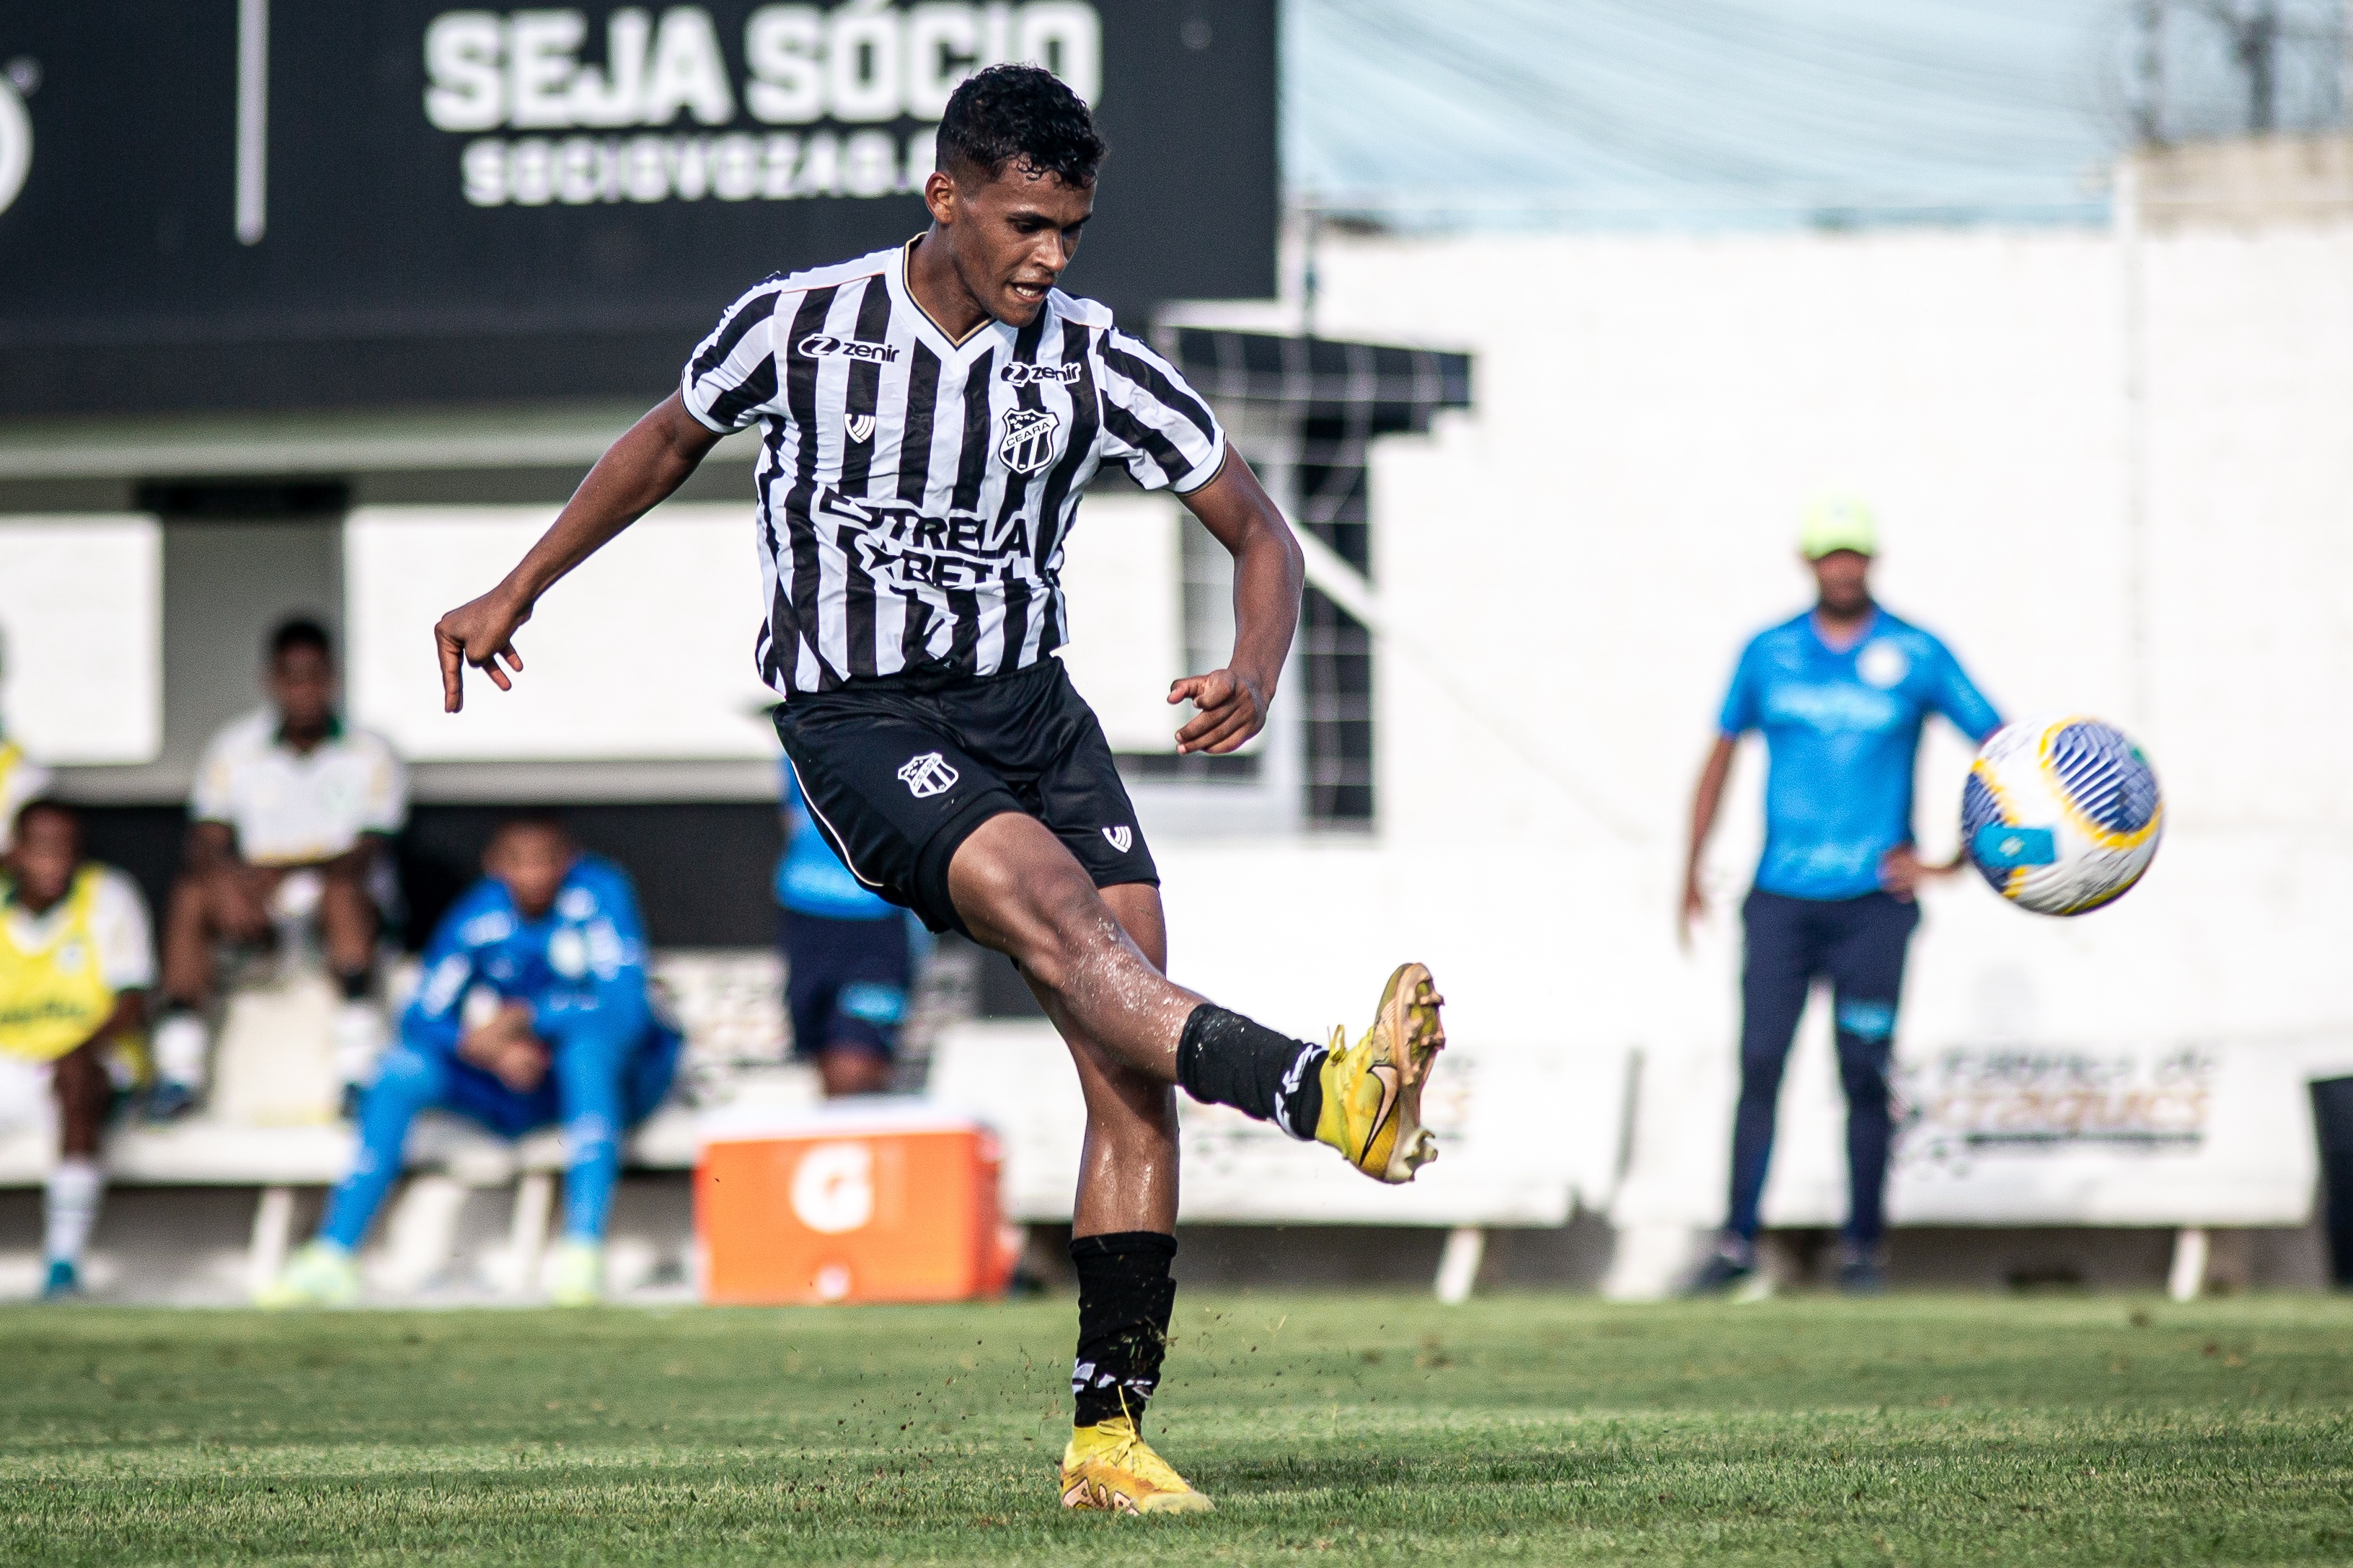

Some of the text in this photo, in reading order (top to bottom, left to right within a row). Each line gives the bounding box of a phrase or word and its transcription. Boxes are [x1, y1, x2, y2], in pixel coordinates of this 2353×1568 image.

[425, 0, 1102, 130] SEJA SÓCIO
[842, 344, 900, 363] zenir
[1031, 365, 1078, 382] zenir
